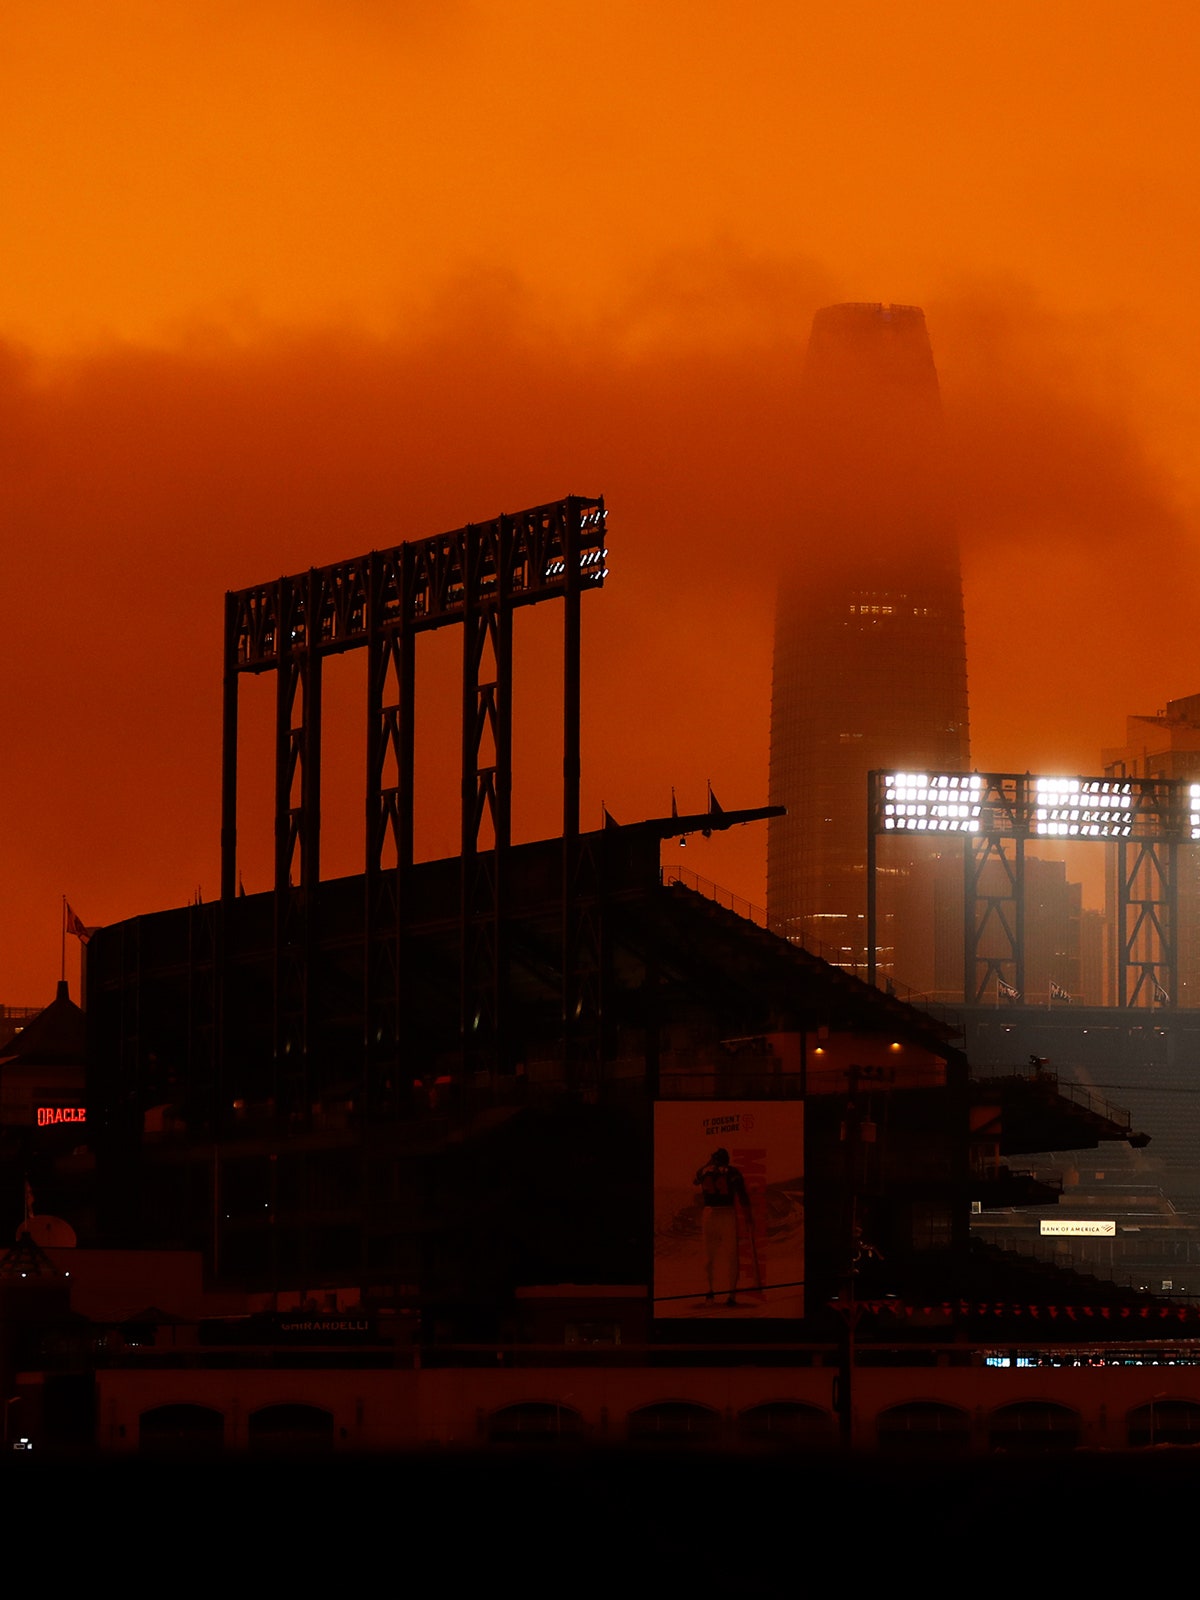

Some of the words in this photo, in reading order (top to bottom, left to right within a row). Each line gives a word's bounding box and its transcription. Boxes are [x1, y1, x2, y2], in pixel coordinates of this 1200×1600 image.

[37, 1107, 87, 1127] ORACLE
[721, 1123, 740, 1133] MORE
[281, 1320, 369, 1331] GHIRARDELLI
